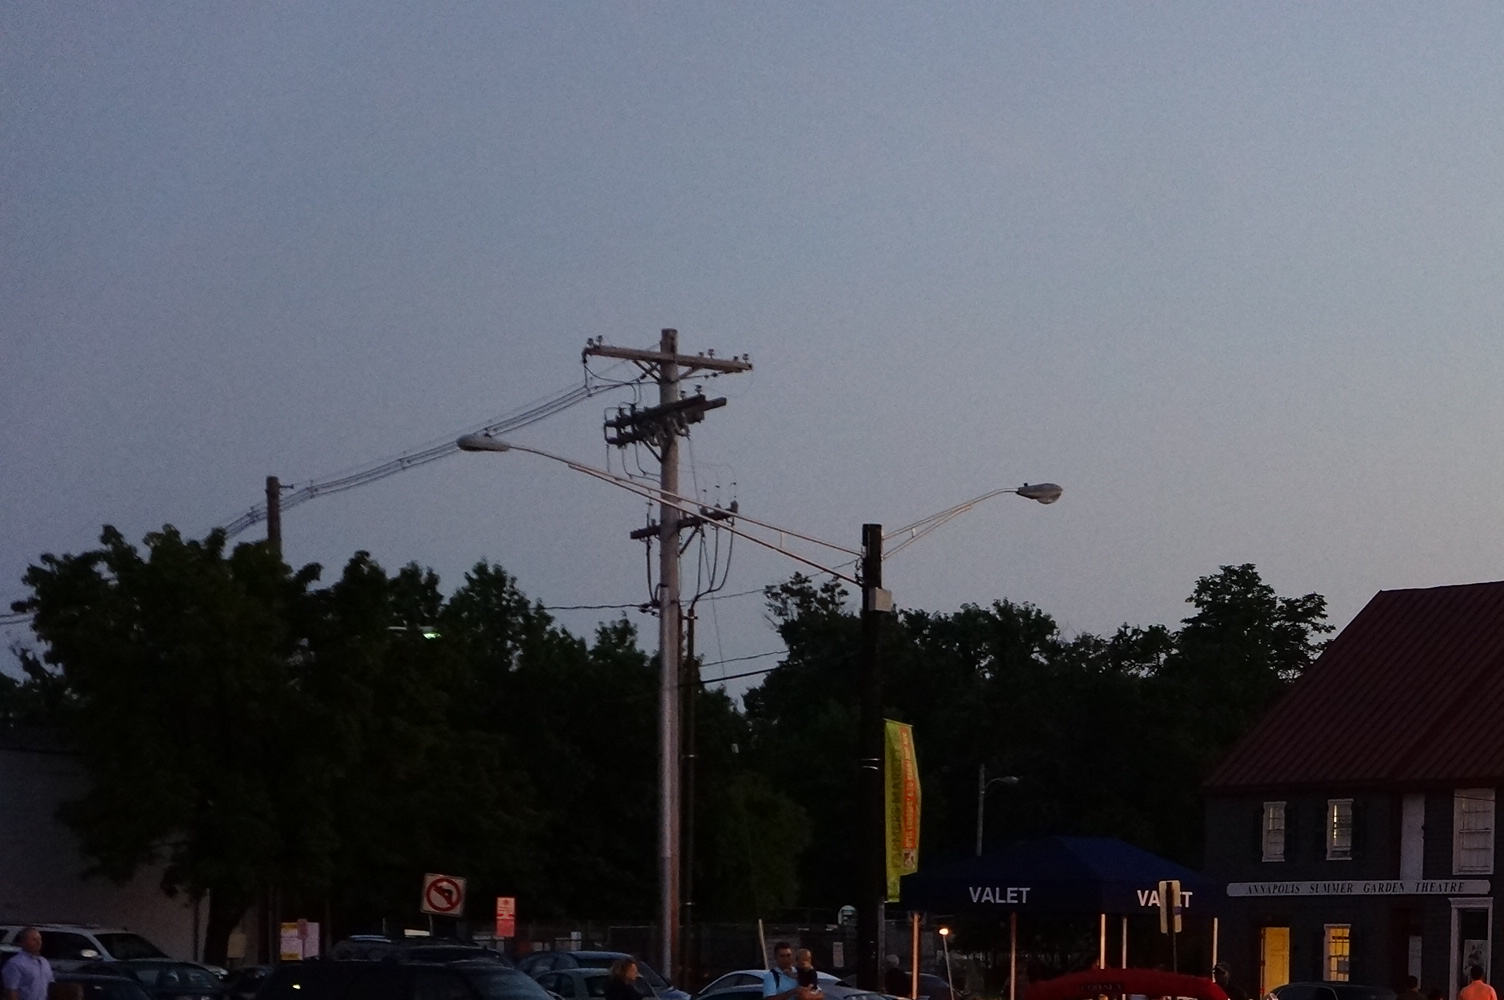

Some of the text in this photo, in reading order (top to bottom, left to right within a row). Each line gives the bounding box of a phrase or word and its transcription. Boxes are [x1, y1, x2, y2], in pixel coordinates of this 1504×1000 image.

[968, 887, 1031, 904] VALET
[1247, 882, 1465, 894] ANNAPOLIS SUMMER GARDEN THEATRE
[1136, 890, 1194, 908] VAT
